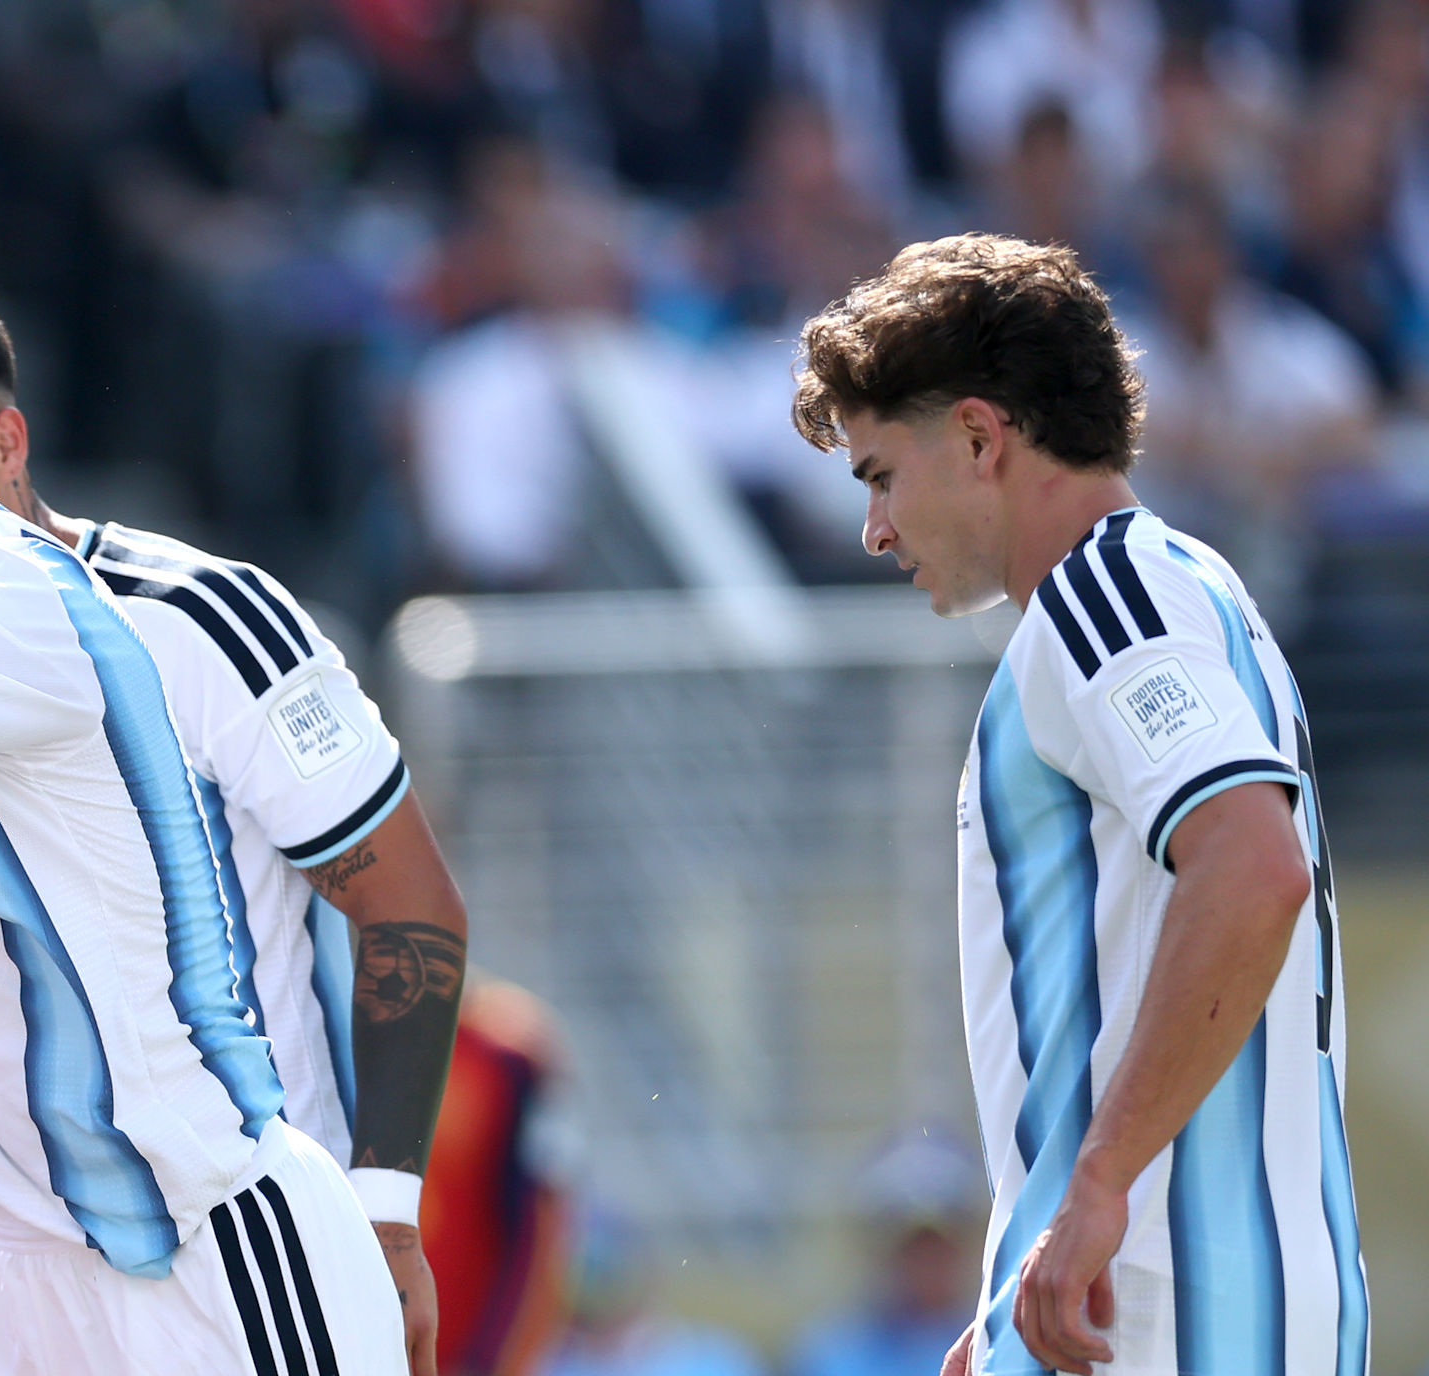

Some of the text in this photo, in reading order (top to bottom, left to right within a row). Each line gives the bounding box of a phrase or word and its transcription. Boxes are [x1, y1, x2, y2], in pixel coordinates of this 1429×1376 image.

[1126, 671, 1178, 709] FOOTBALL
[1134, 682, 1187, 724] UNITES
[286, 700, 331, 738] UNITES
[1145, 695, 1200, 741] the World
[1165, 719, 1187, 737] FIFA
